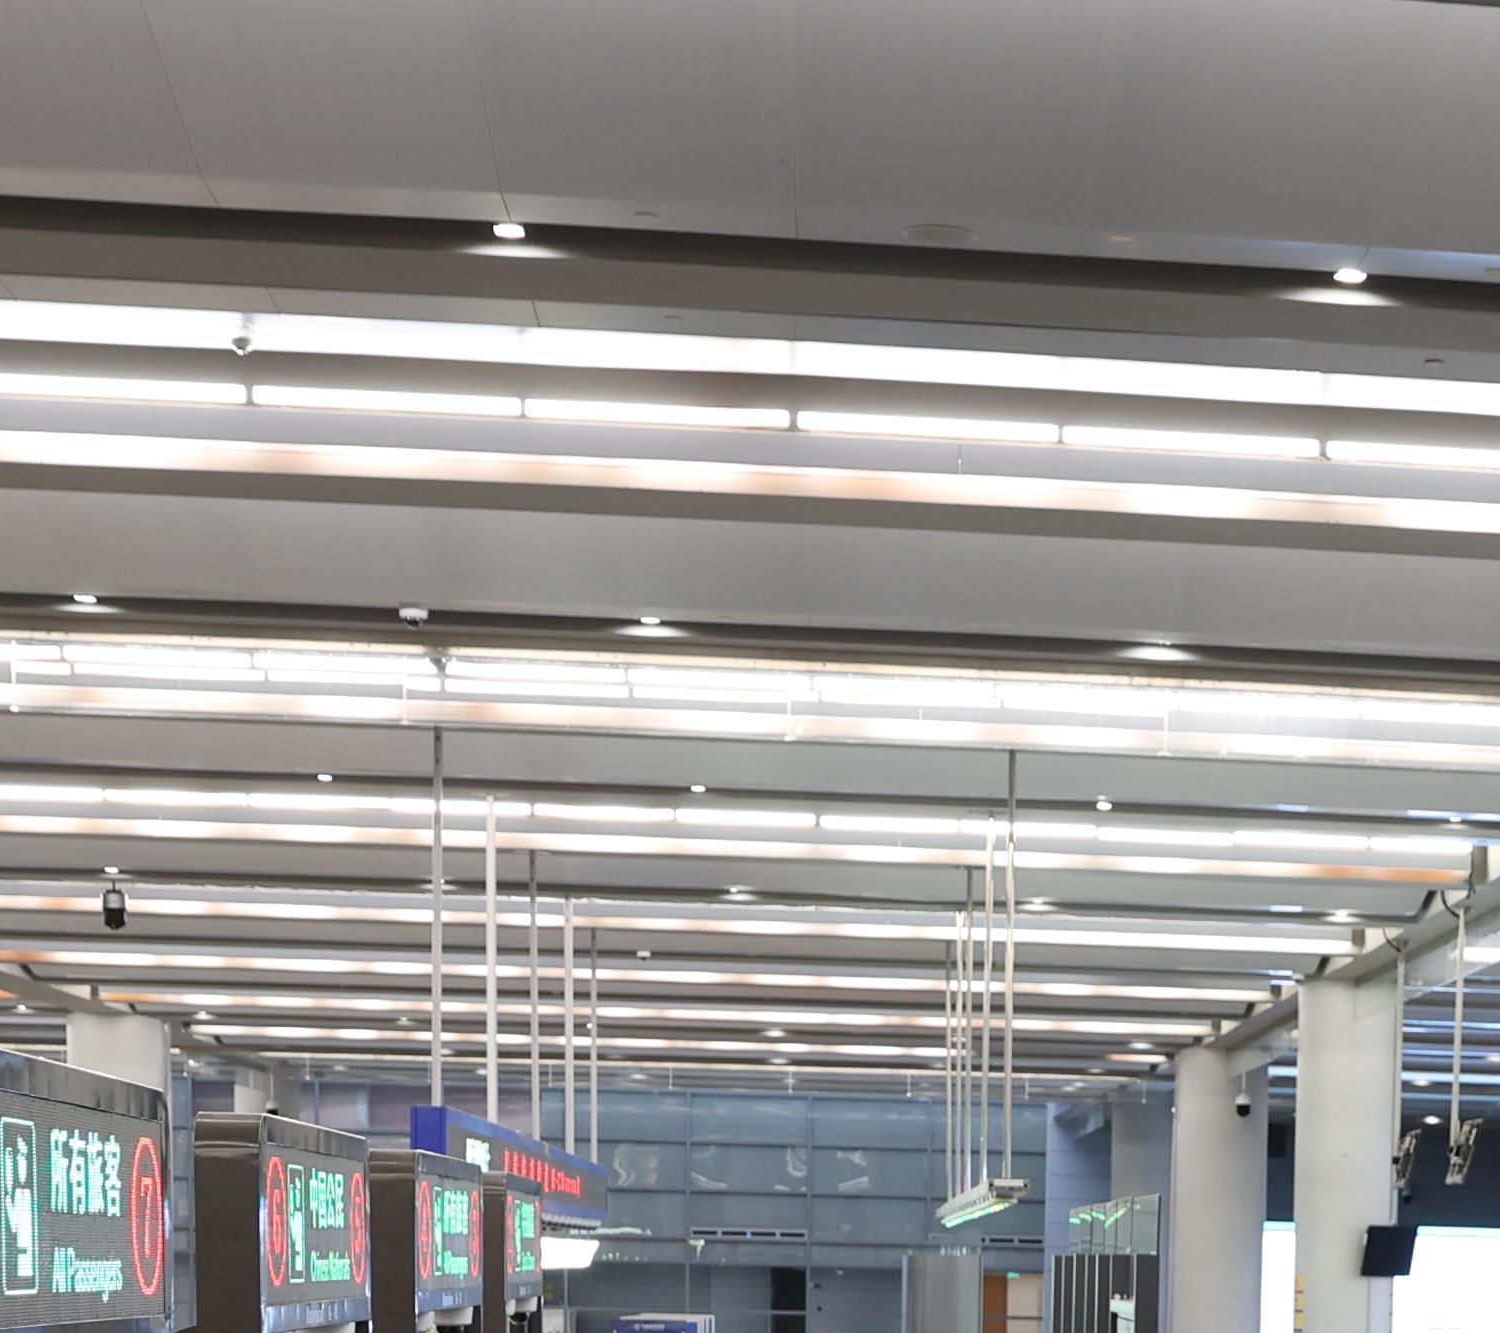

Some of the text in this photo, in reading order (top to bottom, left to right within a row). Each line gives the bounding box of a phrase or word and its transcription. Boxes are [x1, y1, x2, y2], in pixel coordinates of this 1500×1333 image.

[50, 1128, 121, 1217] 所有旅客
[309, 1168, 345, 1229] 中国公民
[140, 1176, 154, 1259] 7
[272, 1189, 282, 1254] 6
[66, 1247, 123, 1304] Passengers
